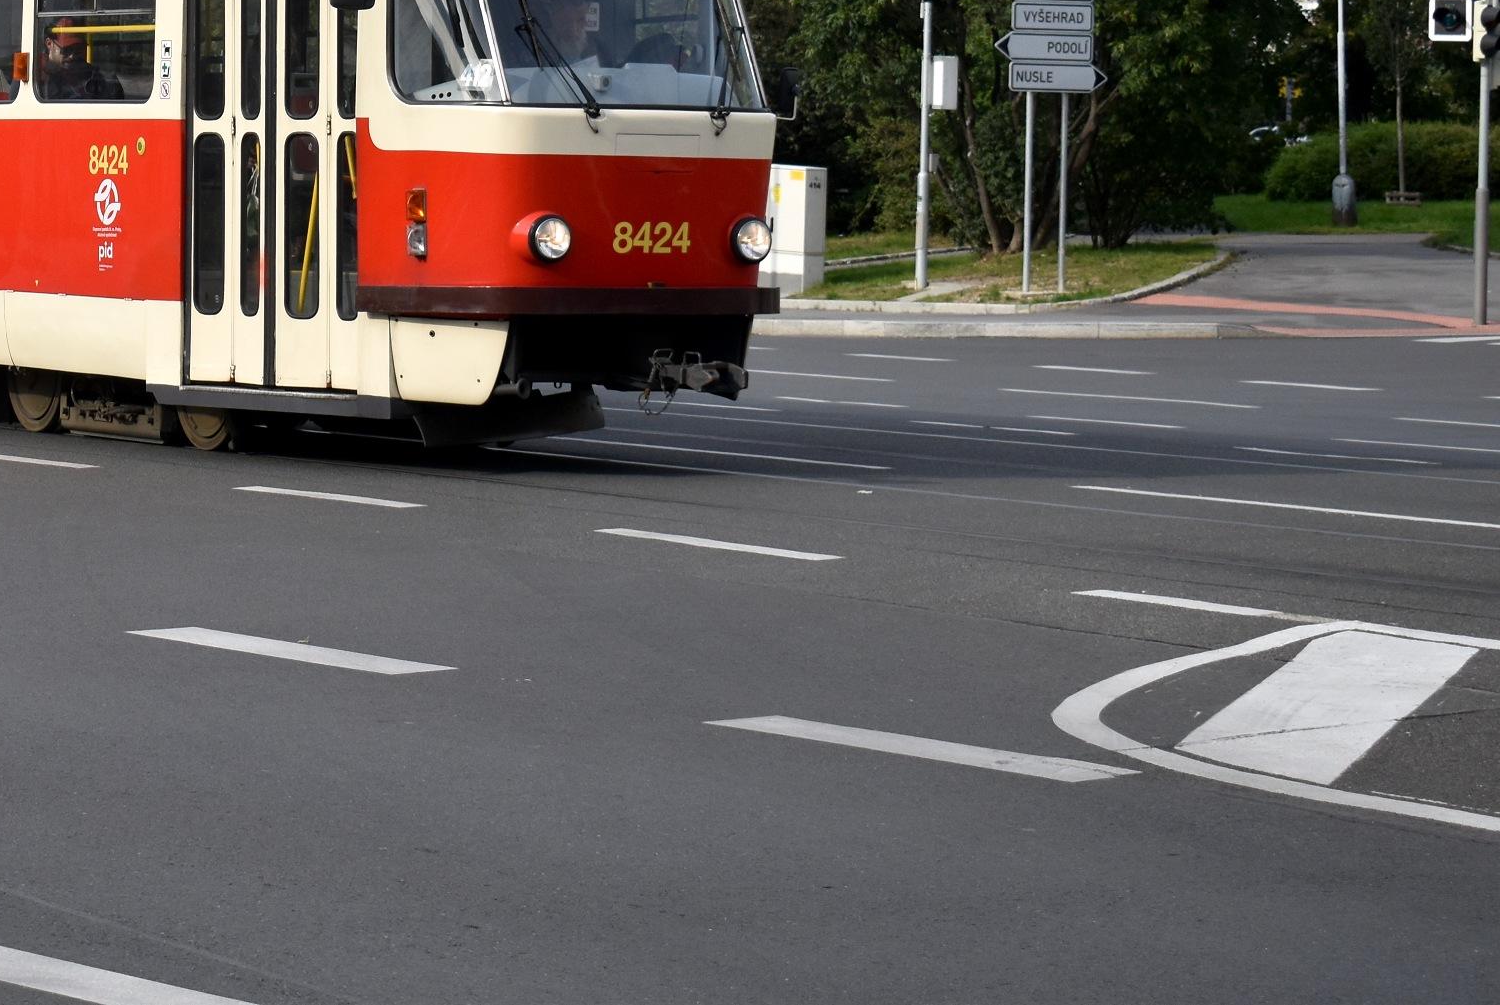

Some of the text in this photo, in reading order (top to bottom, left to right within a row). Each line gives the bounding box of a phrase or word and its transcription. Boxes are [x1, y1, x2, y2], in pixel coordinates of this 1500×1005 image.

[1023, 8, 1084, 24] VYŠEHRAD
[1047, 39, 1089, 54] PODOLÍ
[1015, 70, 1053, 83] NUSLE
[88, 144, 128, 175] 8424
[612, 221, 691, 254] 8424
[98, 241, 113, 262] pid
